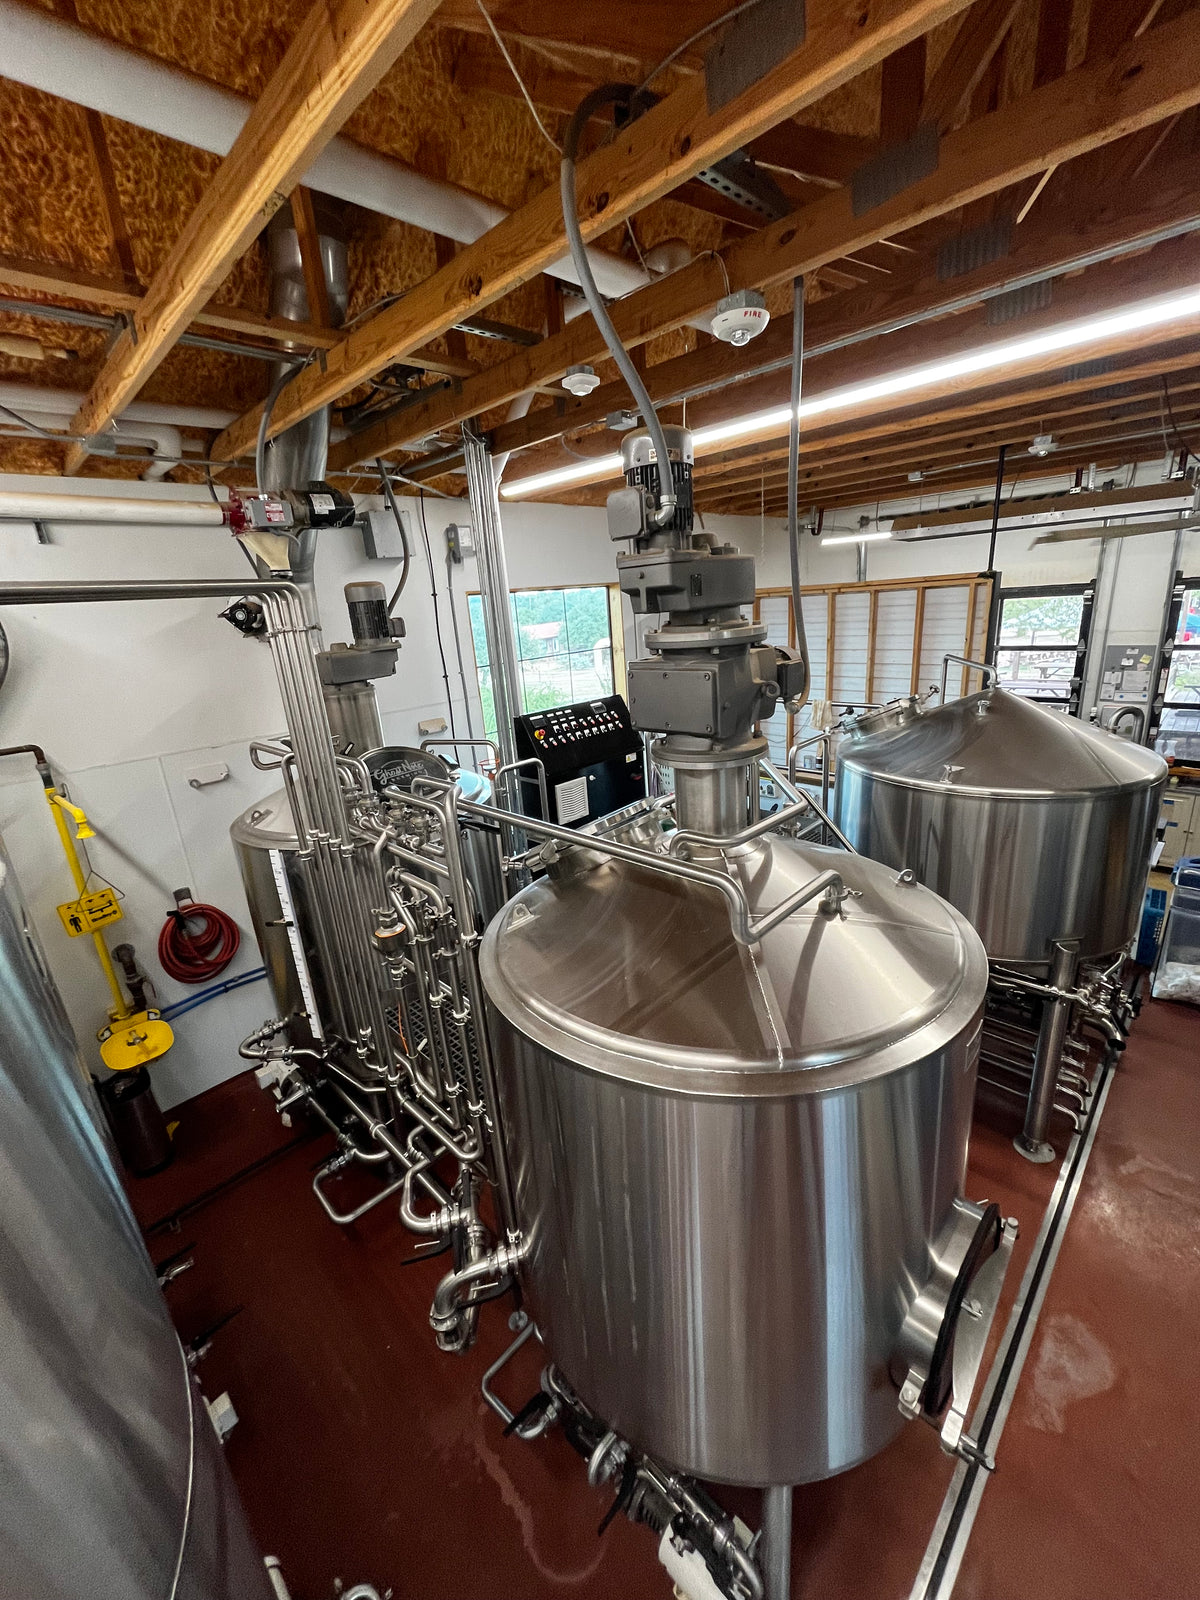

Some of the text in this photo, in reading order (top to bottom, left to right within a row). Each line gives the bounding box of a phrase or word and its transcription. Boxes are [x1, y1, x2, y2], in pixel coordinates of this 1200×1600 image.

[743, 310, 762, 319] FIRE
[373, 759, 425, 785] Ghost Note
